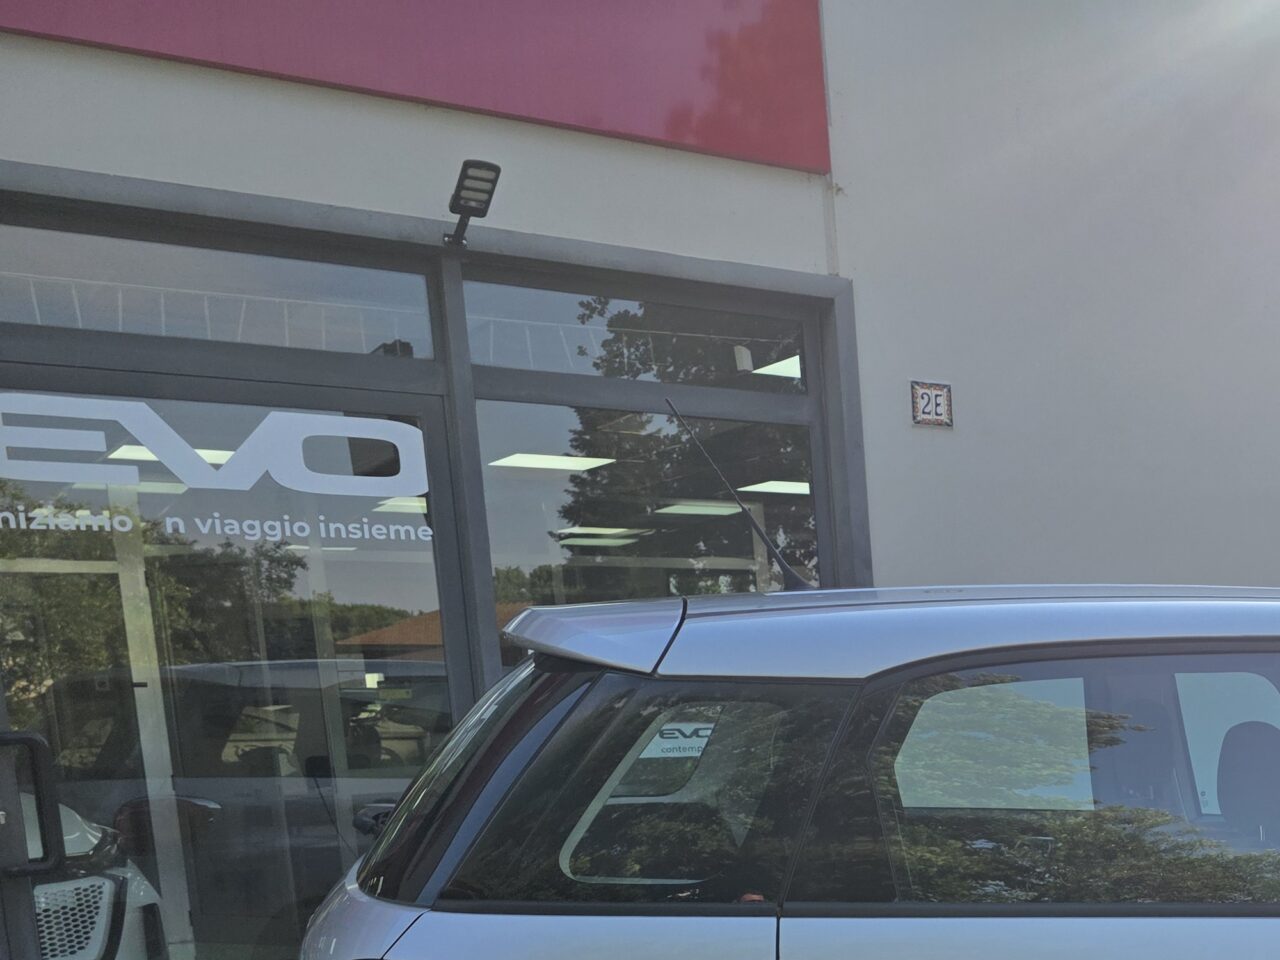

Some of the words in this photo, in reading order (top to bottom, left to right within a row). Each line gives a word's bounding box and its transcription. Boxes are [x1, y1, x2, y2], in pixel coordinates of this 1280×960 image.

[920, 392, 943, 417] 2E
[0, 392, 429, 497] EVO
[194, 512, 311, 541] viaggio
[318, 514, 433, 541] insieme
